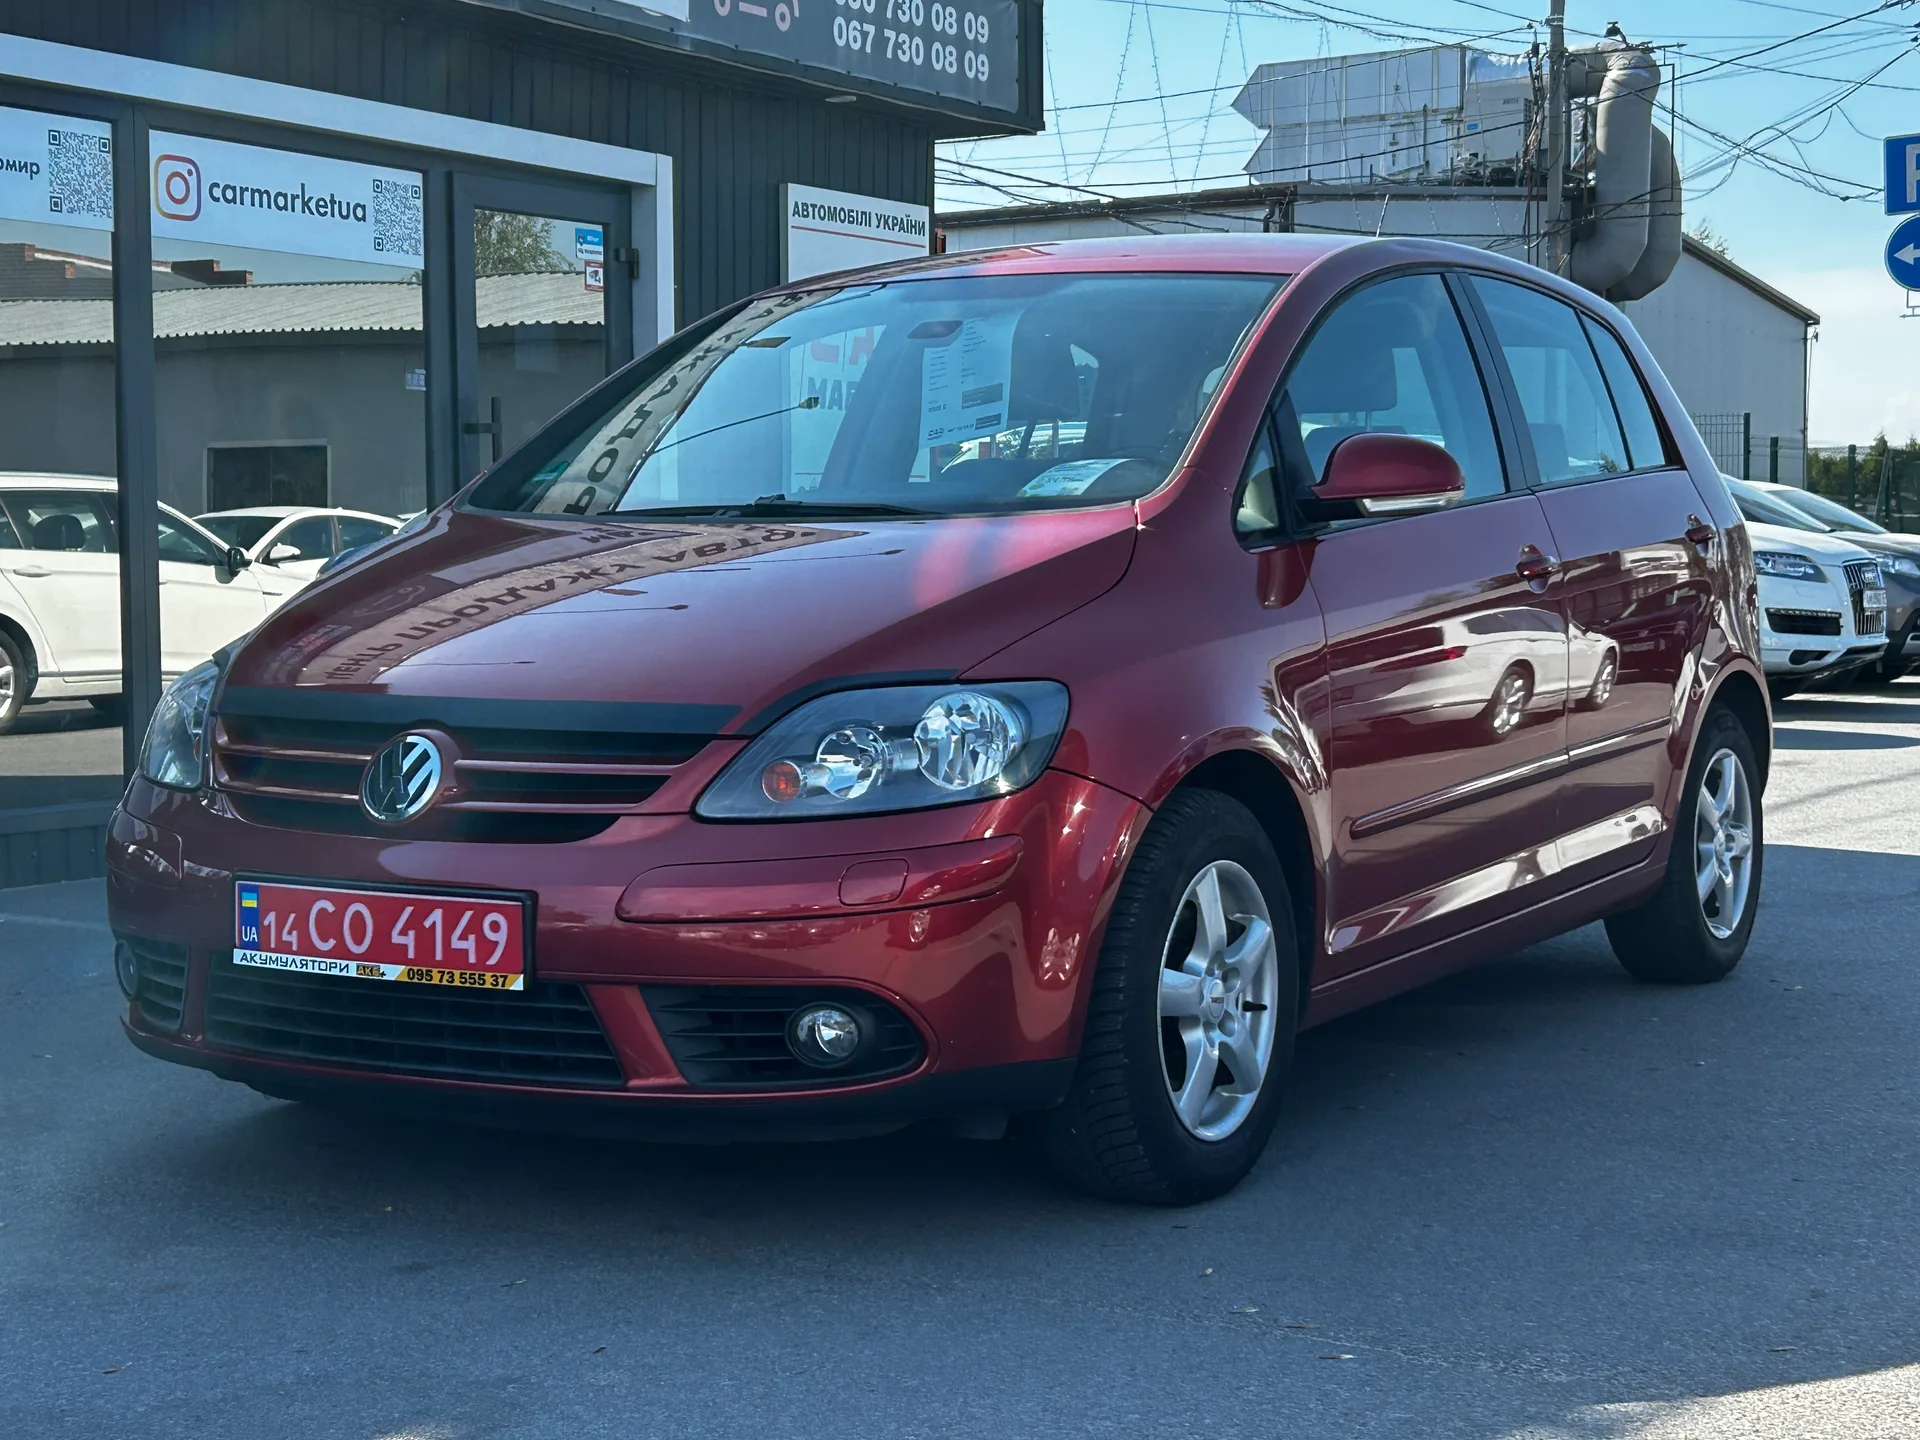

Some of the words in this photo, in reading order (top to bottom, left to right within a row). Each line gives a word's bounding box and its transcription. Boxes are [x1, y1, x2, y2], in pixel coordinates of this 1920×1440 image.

[886, 0, 924, 26] 730
[931, 3, 957, 35] 08
[964, 11, 989, 44] 09
[833, 16, 875, 53] 067
[884, 29, 924, 66] 730
[931, 41, 957, 74] 08
[964, 50, 989, 82] 09
[208, 183, 367, 222] carmarketua
[792, 201, 871, 228] АВТОМОБІЛІ
[875, 213, 926, 237] УКРАЇНИ
[242, 925, 258, 942] UA
[391, 906, 508, 966] 4149
[240, 952, 350, 974] АКУМУЛЯТОРИ
[407, 967, 434, 983] 095
[437, 970, 456, 985] 73
[459, 972, 486, 987] 555
[490, 974, 509, 988] 37
